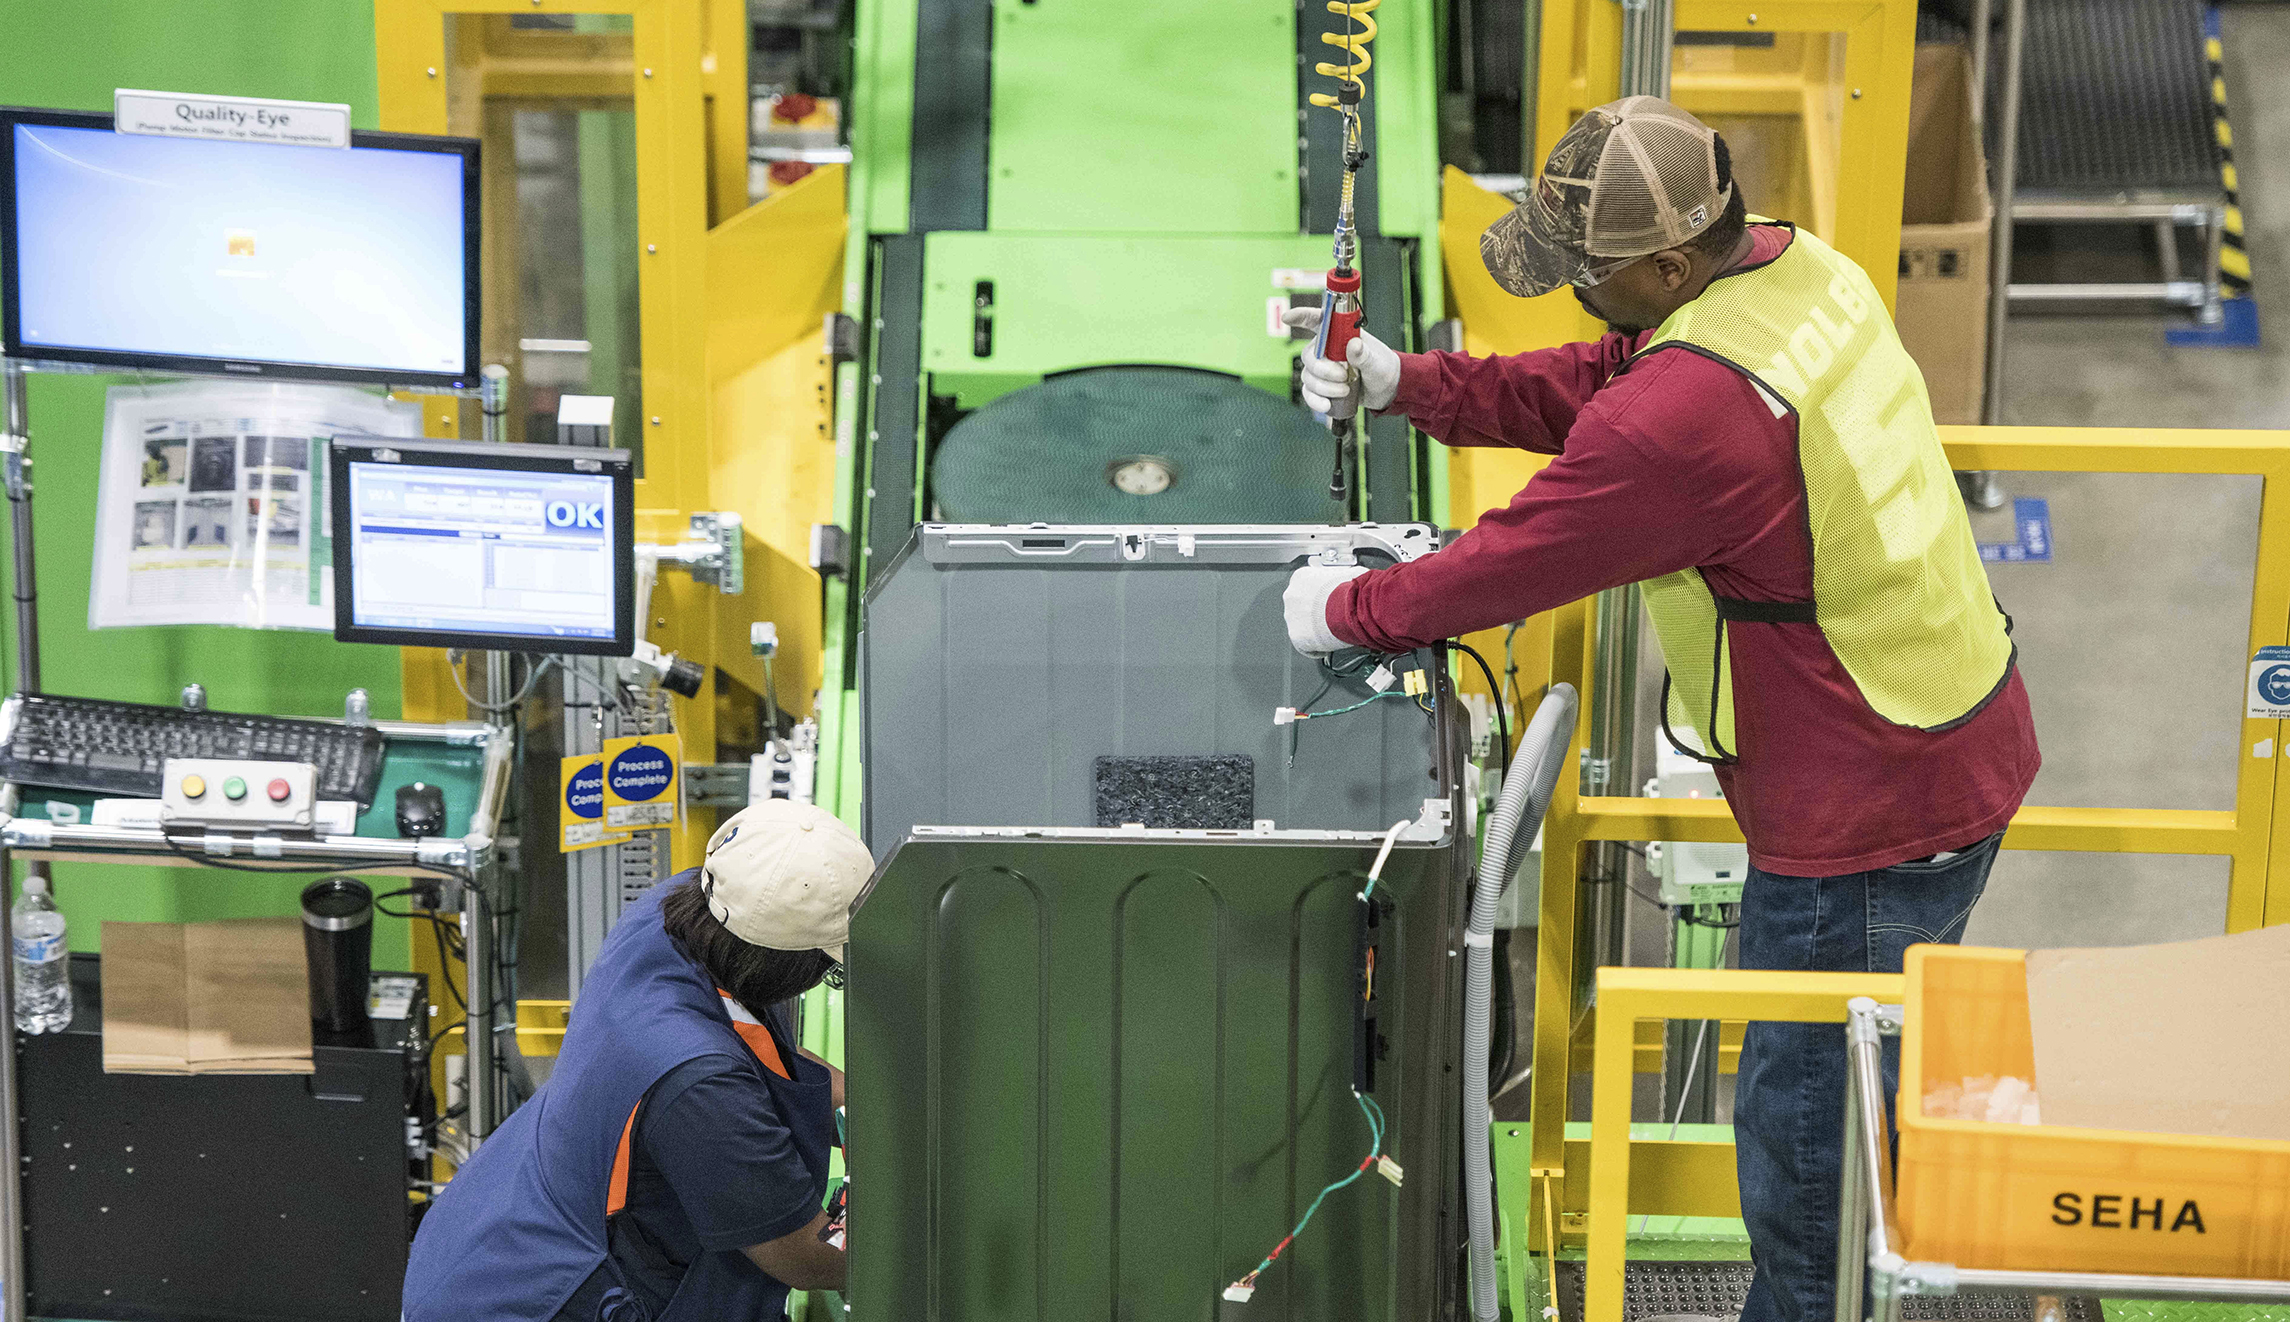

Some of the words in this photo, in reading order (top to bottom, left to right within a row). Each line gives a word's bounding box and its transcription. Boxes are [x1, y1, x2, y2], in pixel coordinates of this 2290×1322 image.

[175, 103, 290, 128] Quality-Eye
[546, 501, 604, 529] OK
[618, 760, 664, 773] Process
[576, 778, 603, 790] Proc
[613, 775, 668, 788] Complete
[2051, 1192, 2206, 1234] SEHA
